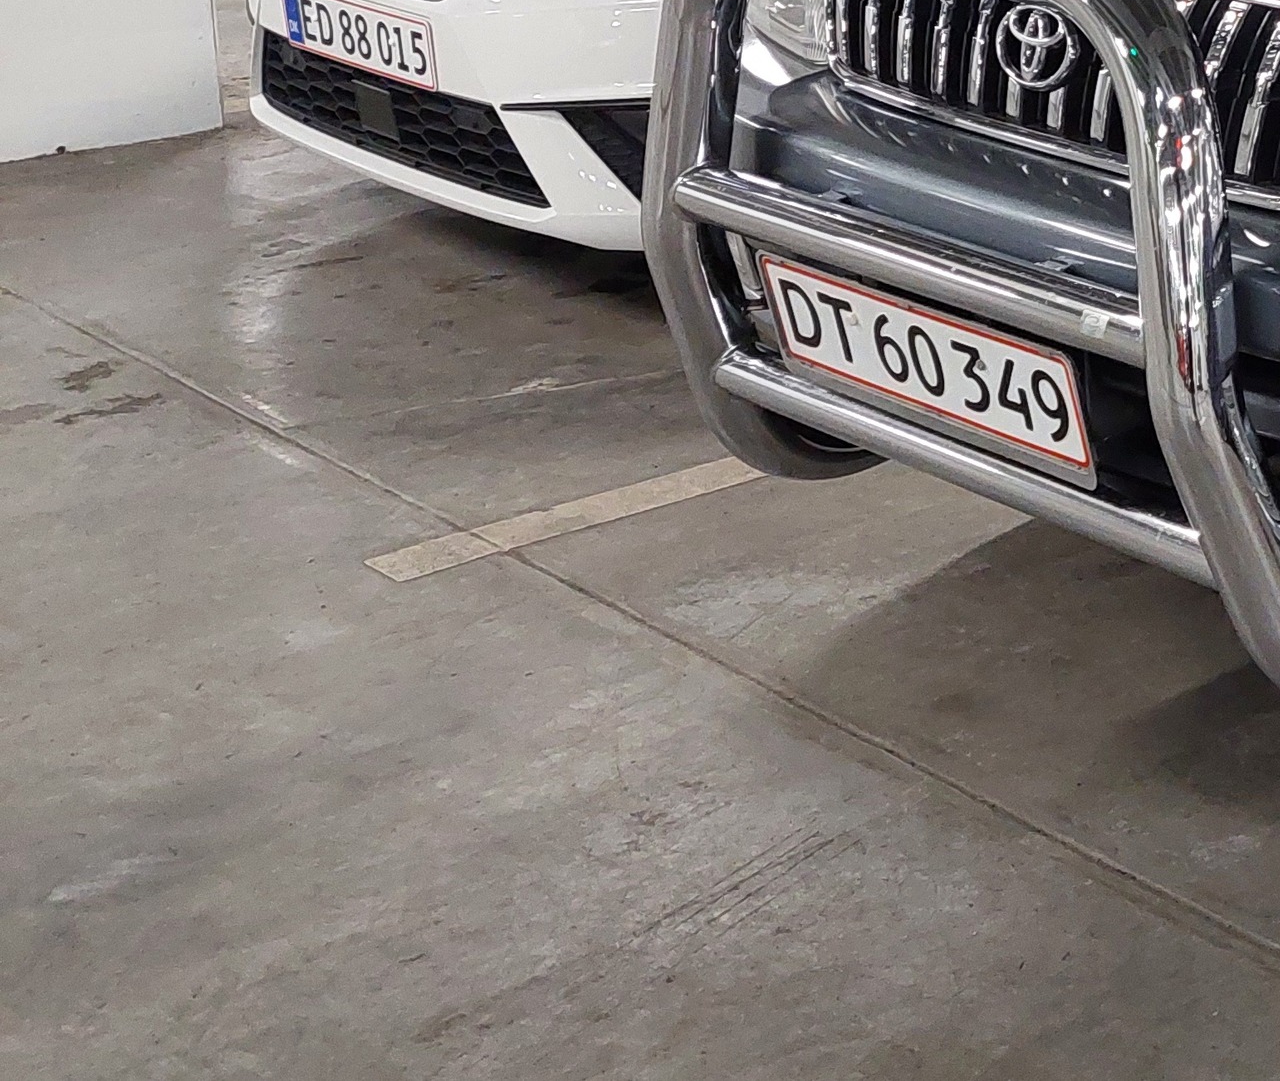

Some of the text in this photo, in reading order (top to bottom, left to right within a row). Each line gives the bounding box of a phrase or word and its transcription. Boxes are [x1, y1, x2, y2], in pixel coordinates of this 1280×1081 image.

[338, 9, 372, 60] 88
[376, 21, 427, 76] 015
[777, 278, 1070, 443] DT 60 349
